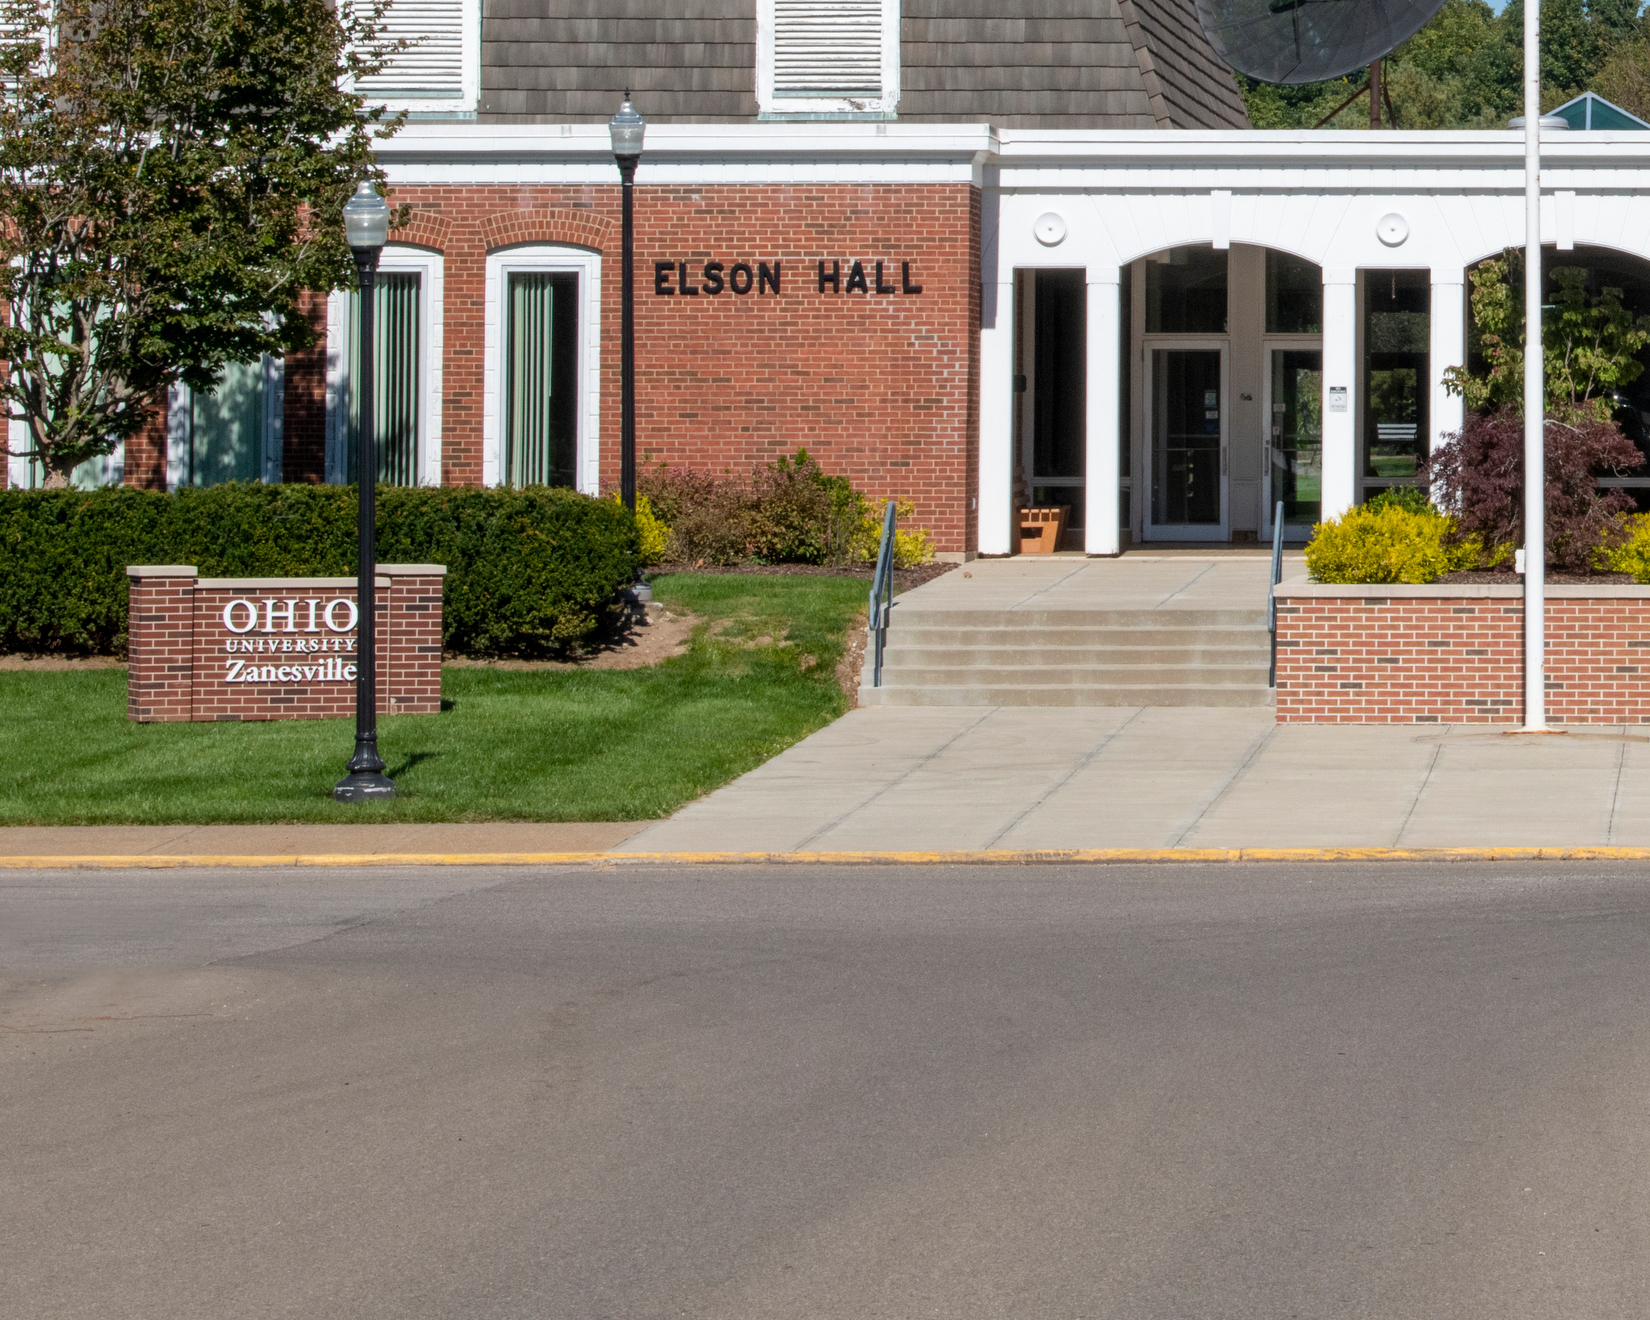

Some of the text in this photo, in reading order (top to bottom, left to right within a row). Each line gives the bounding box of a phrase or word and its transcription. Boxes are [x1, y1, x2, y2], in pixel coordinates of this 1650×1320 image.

[655, 260, 923, 296] ELSON HALL
[223, 598, 358, 634] OHIO
[225, 638, 356, 653] UNIVERSITY
[225, 657, 358, 683] Zanesville
